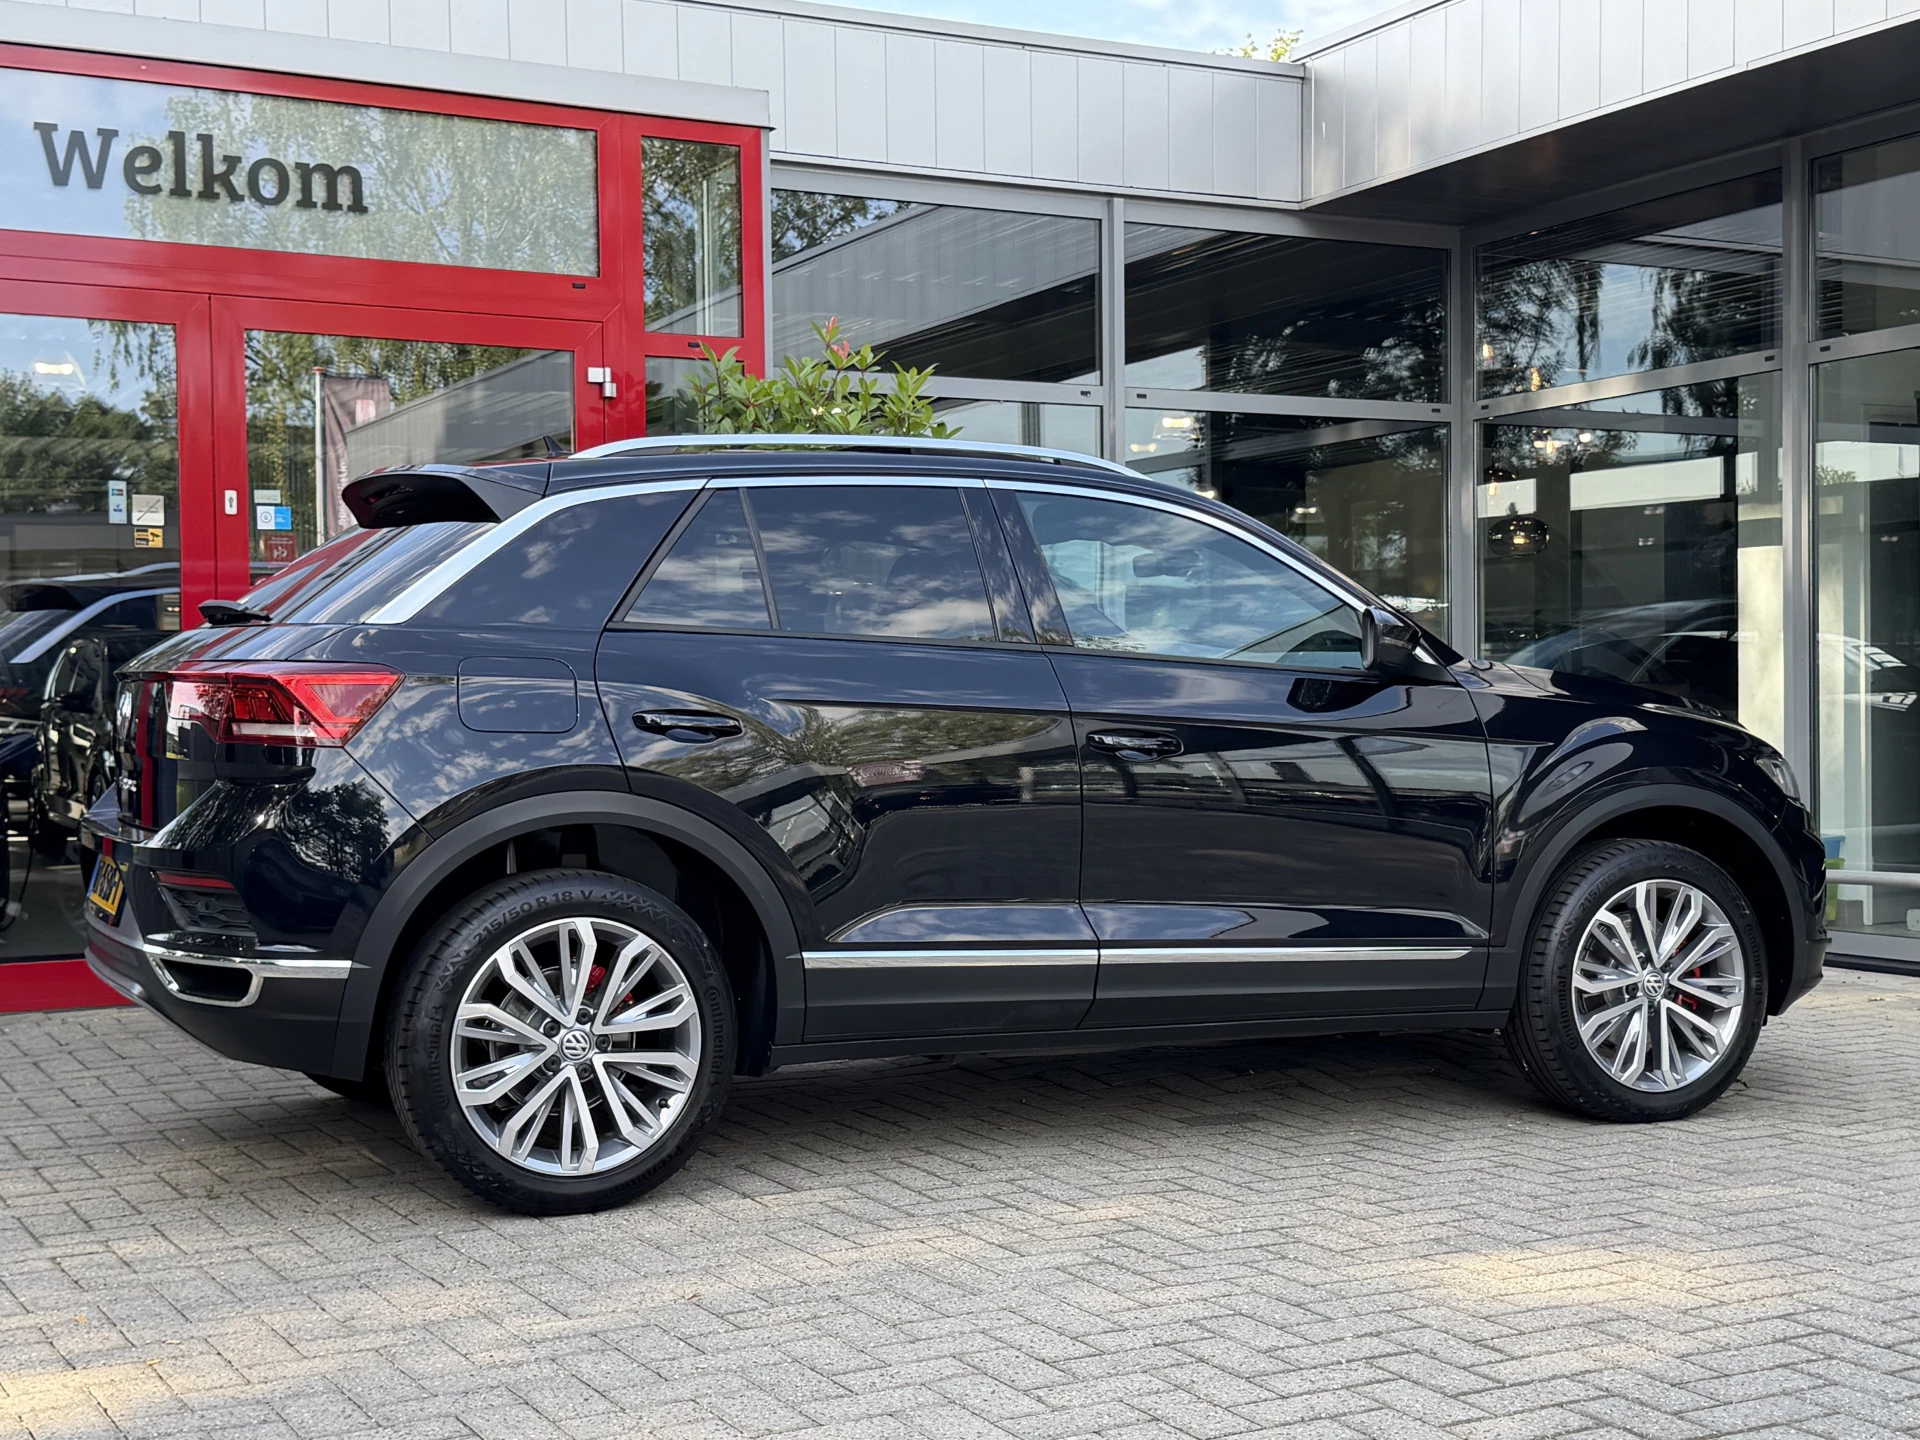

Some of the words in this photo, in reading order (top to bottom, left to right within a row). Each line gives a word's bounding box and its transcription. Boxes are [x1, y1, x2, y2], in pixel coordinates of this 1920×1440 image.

[33, 121, 368, 214] Welkom
[472, 901, 533, 945] 215/50
[580, 889, 594, 901] V
[704, 986, 726, 1075] Continental
[1557, 975, 1578, 1049] Continental
[428, 1016, 449, 1109] Continental
